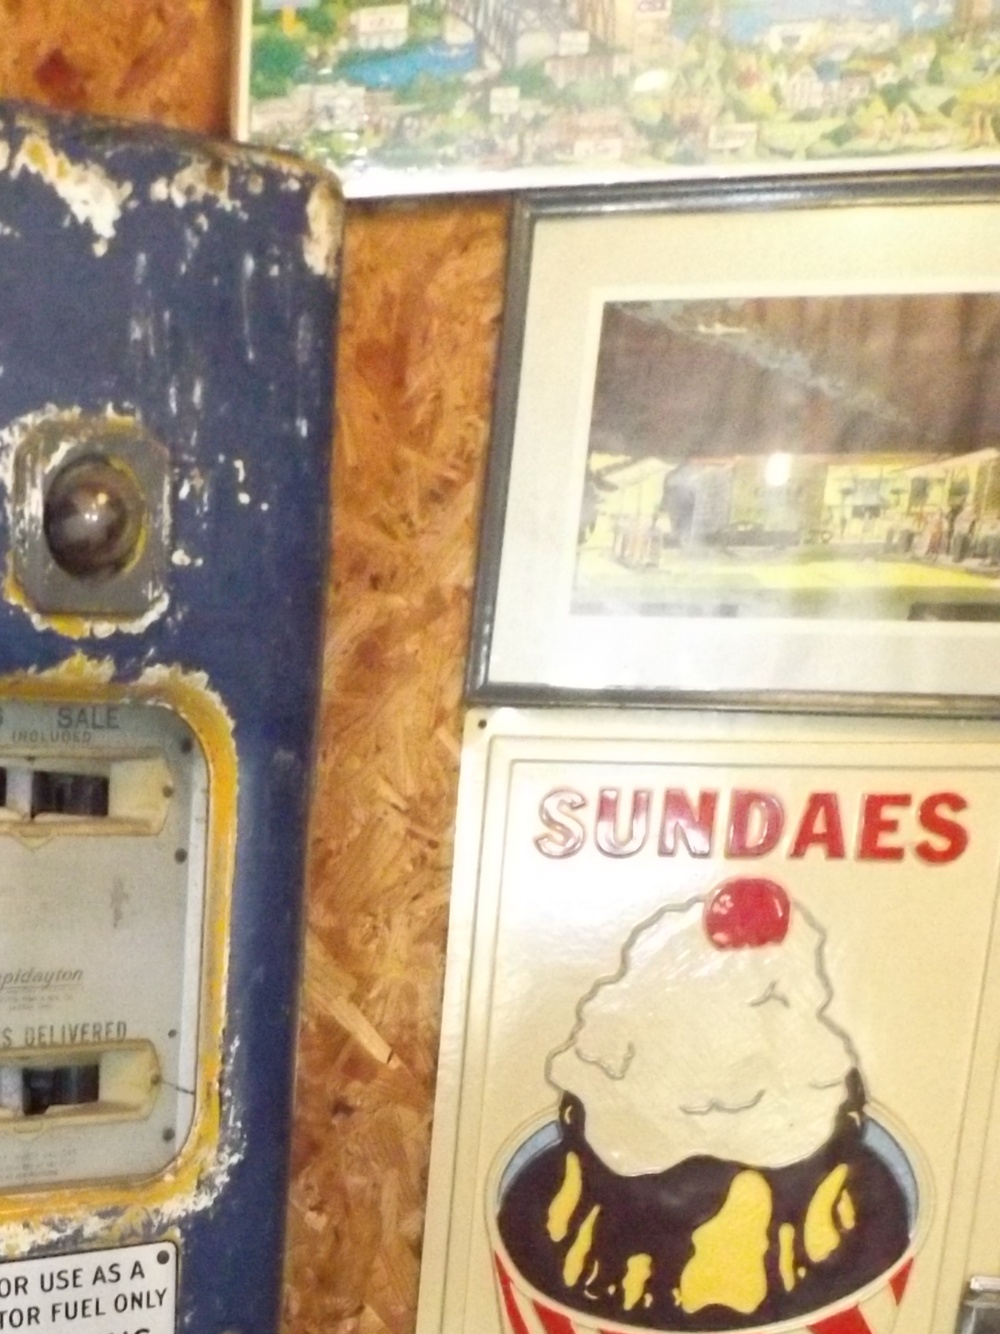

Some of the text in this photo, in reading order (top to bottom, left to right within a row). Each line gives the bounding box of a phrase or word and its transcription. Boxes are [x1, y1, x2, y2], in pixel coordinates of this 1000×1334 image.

[57, 706, 121, 729] SALE
[12, 729, 92, 744] INCLUDED
[533, 787, 970, 866] SUNDAES
[24, 1021, 127, 1048] DELIVERED
[40, 1268, 83, 1293] USE
[92, 1263, 121, 1286] AS
[130, 1260, 146, 1280] A
[51, 1297, 106, 1322] FUEL
[114, 1288, 168, 1313] ONLY
